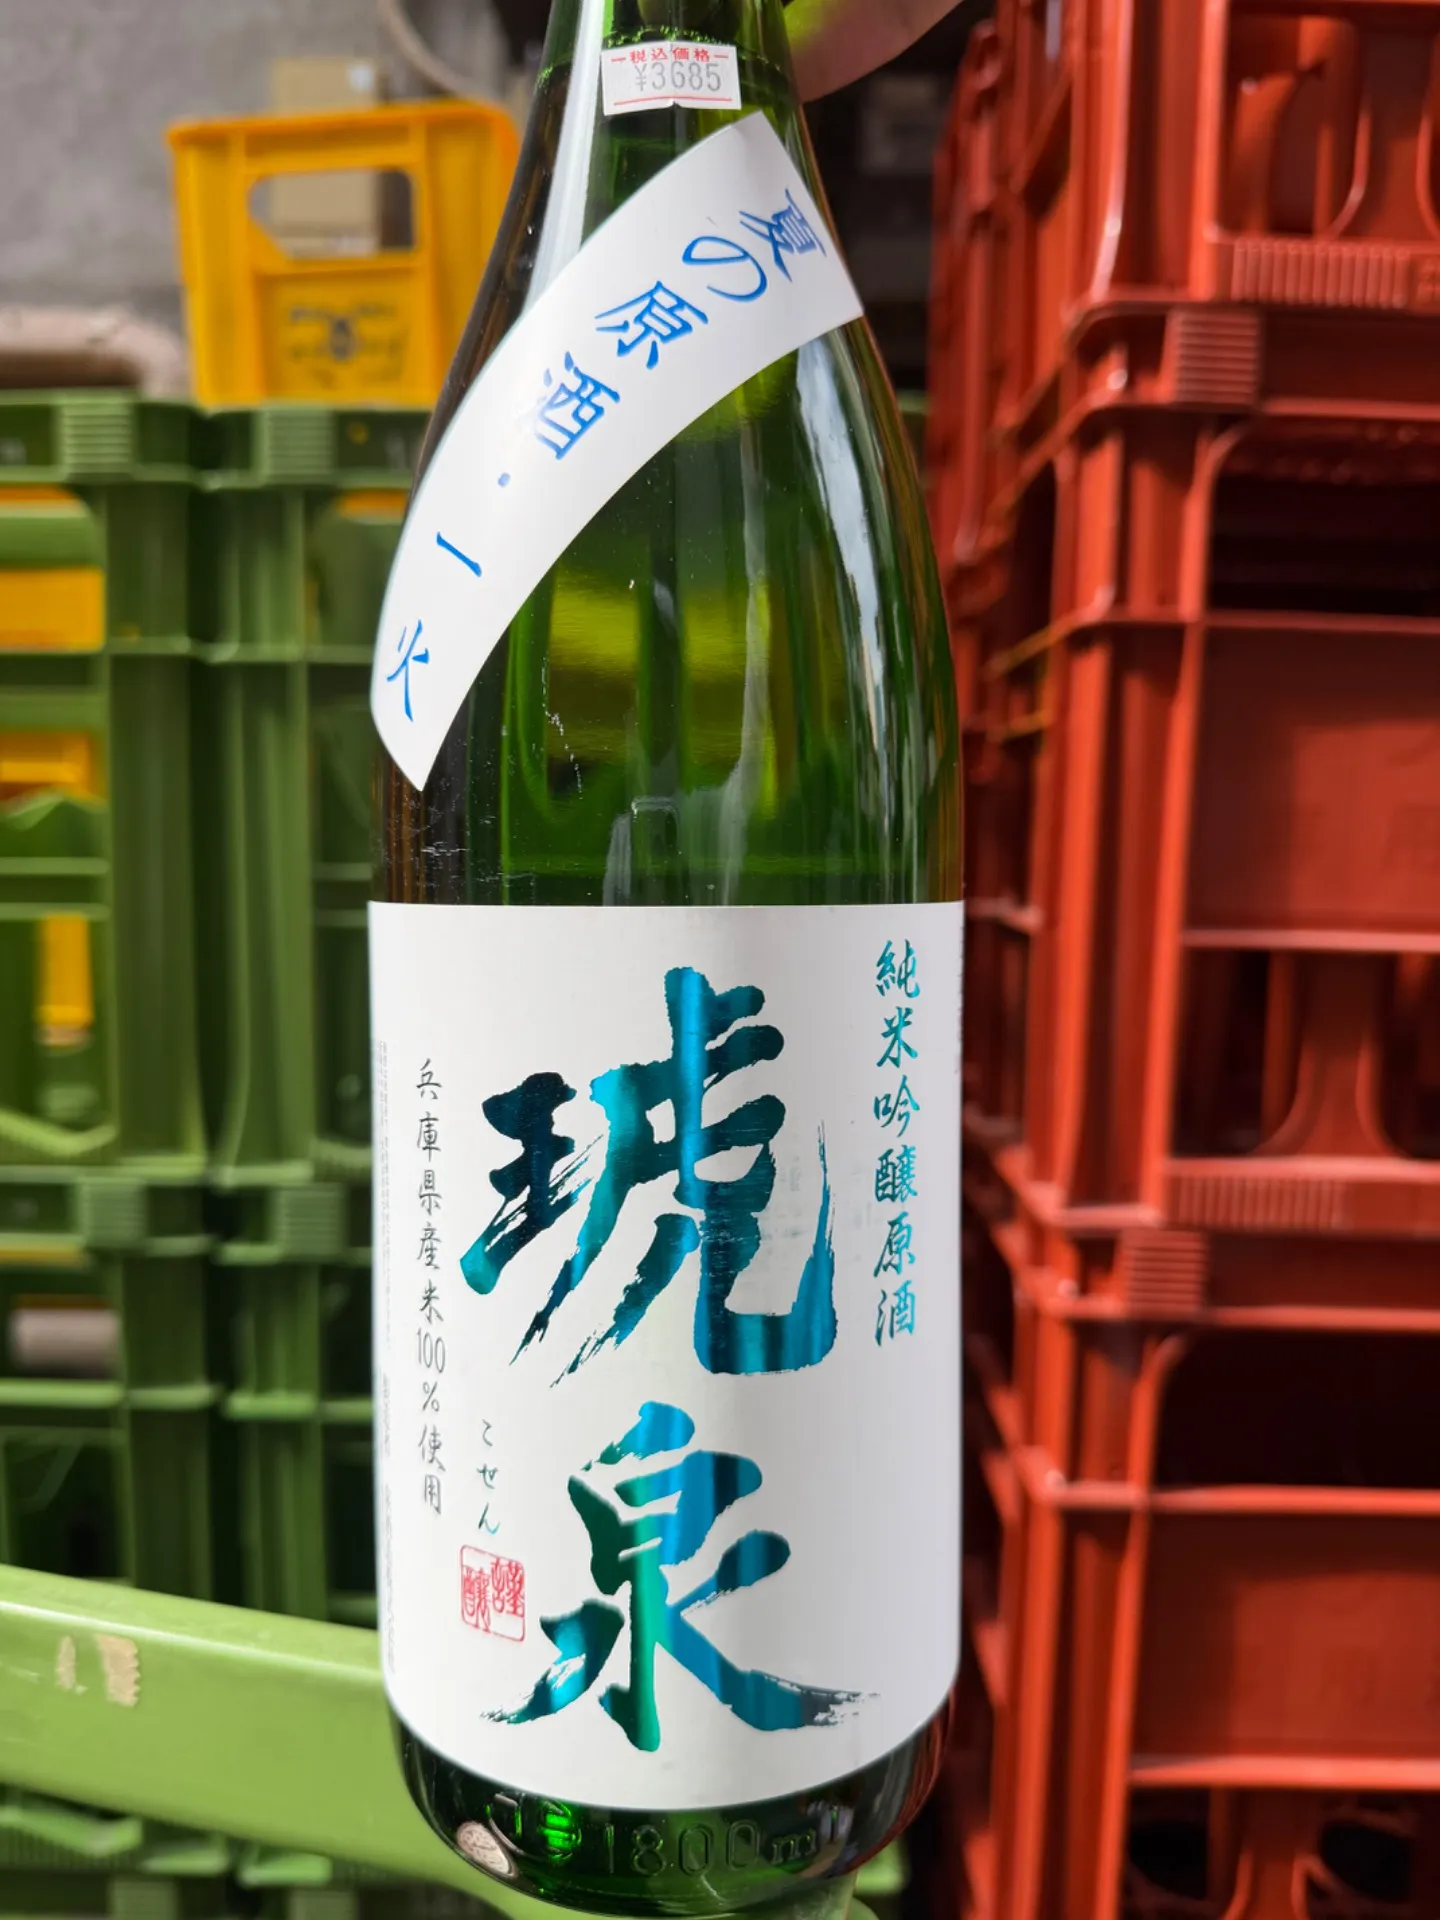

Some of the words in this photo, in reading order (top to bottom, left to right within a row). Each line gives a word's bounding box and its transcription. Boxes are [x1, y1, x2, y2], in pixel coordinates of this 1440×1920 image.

[634, 61, 722, 92] ¥3685
[873, 939, 921, 1347] 純米吟醸原酒
[459, 966, 882, 1753] 琥泉
